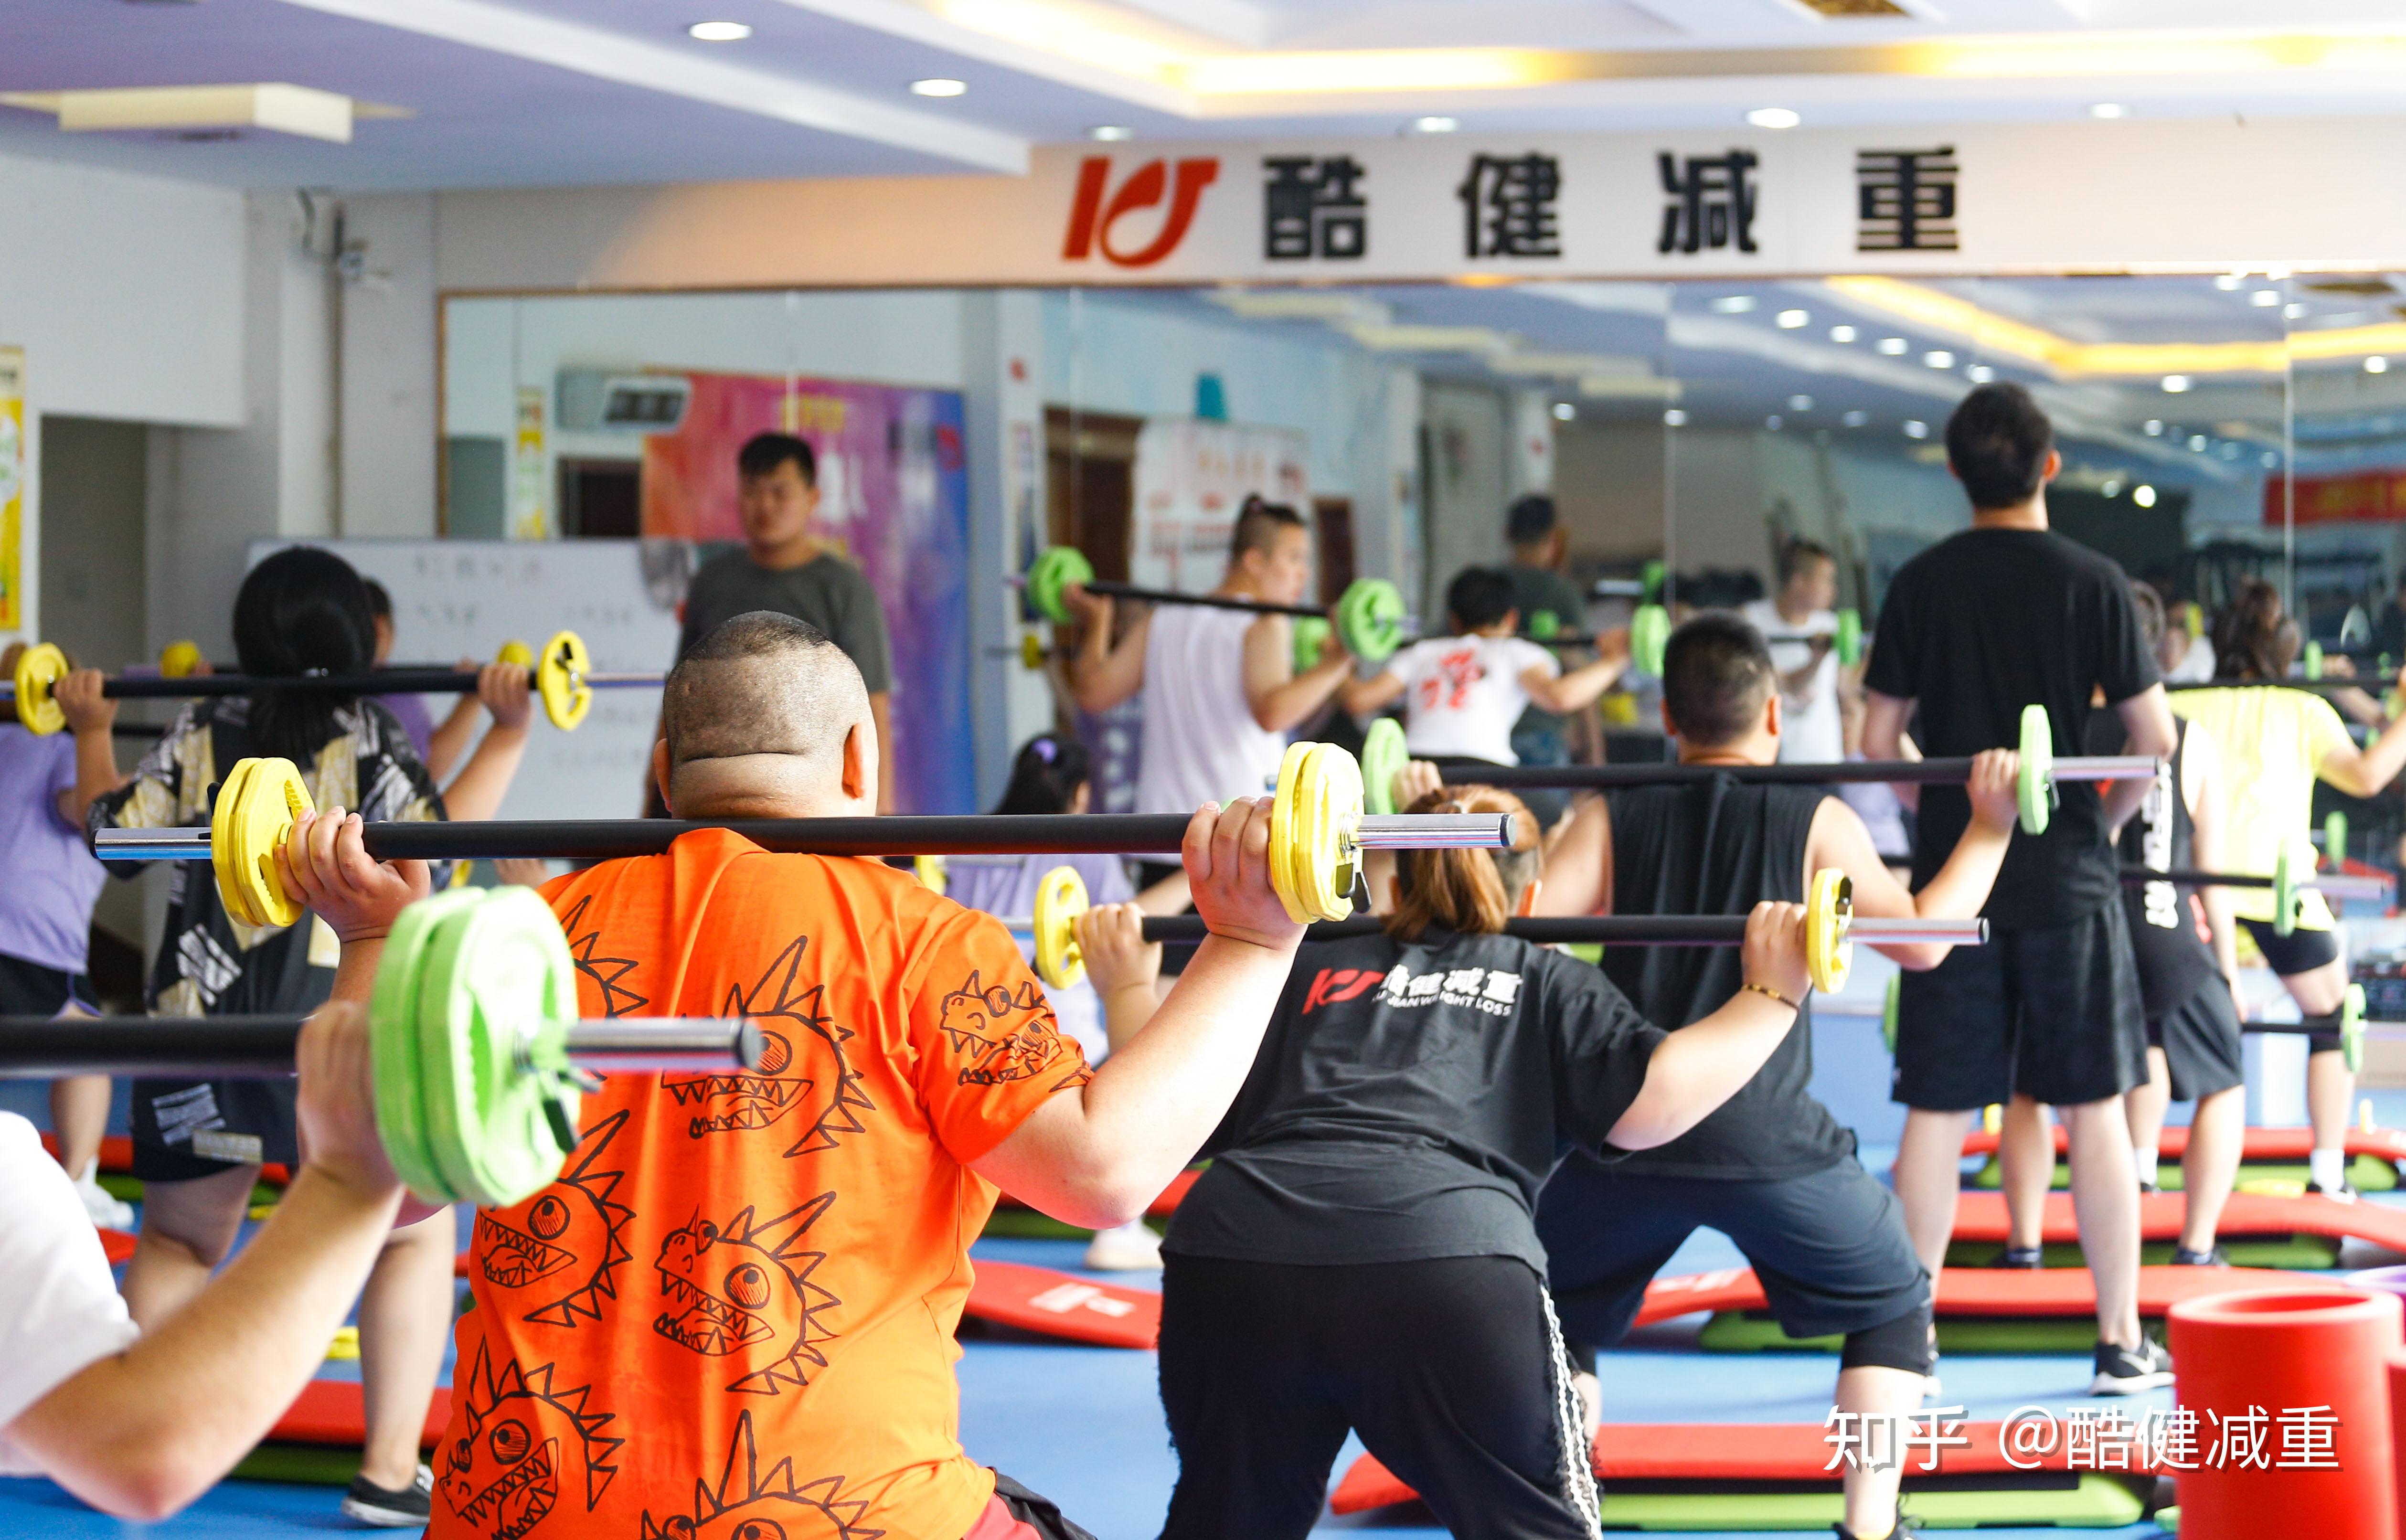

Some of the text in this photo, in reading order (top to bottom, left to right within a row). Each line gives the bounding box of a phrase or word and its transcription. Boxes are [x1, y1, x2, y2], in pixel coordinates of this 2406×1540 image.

[1261, 146, 1960, 262] 酷健减重
[1387, 995, 1420, 1008] JIAN
[1420, 990, 1476, 1008] WIGHT
[1475, 997, 1513, 1017] LOSS
